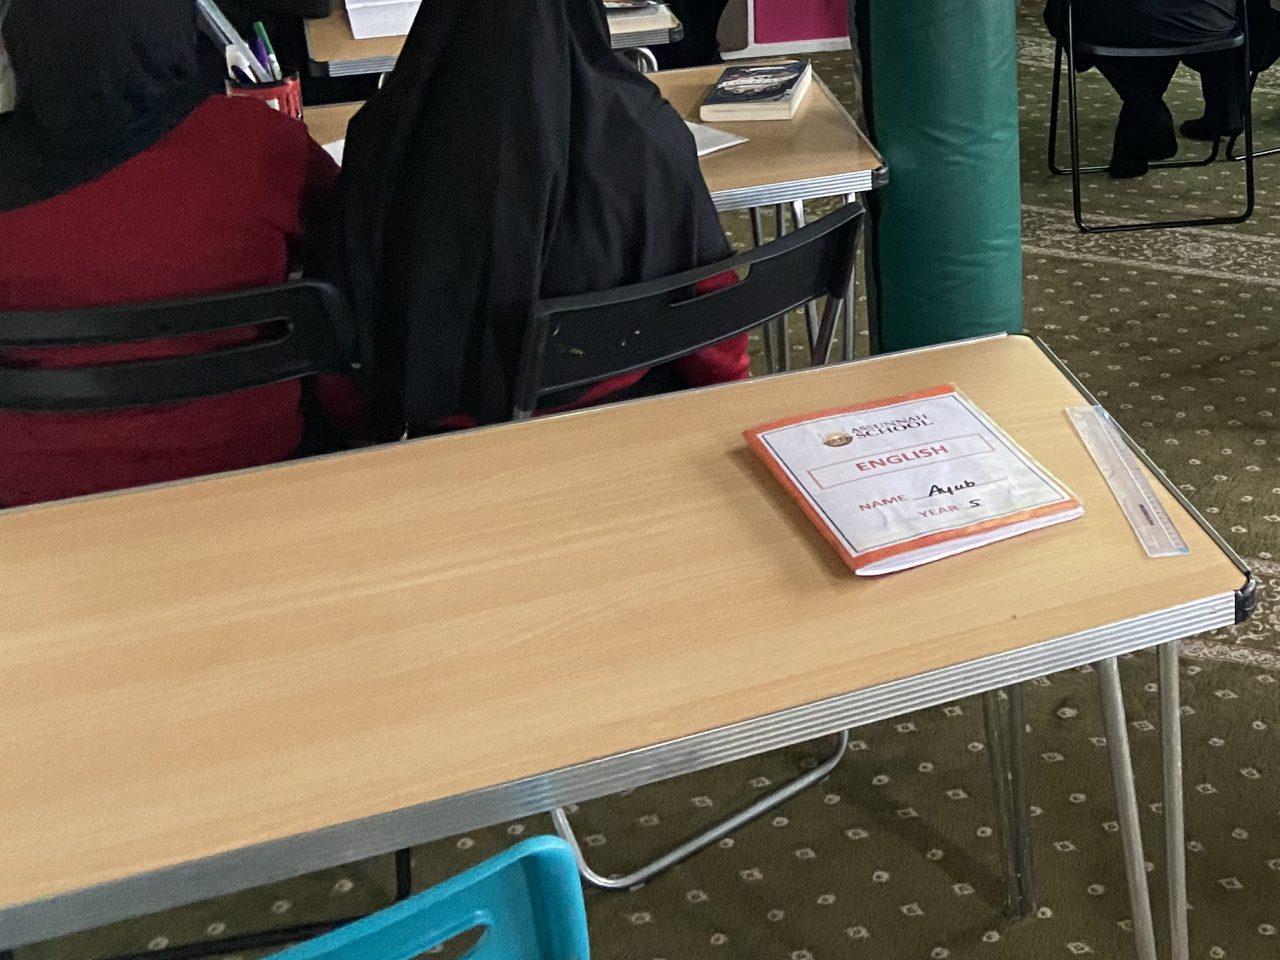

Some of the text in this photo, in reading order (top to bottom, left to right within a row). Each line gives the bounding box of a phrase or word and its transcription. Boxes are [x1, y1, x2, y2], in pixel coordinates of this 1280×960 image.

[851, 413, 928, 434] ASSUNNAH
[856, 419, 935, 439] SCHOOL
[855, 444, 949, 472] ENGLISH
[858, 480, 976, 512] NAME Ayub
[918, 504, 960, 518] YEAR
